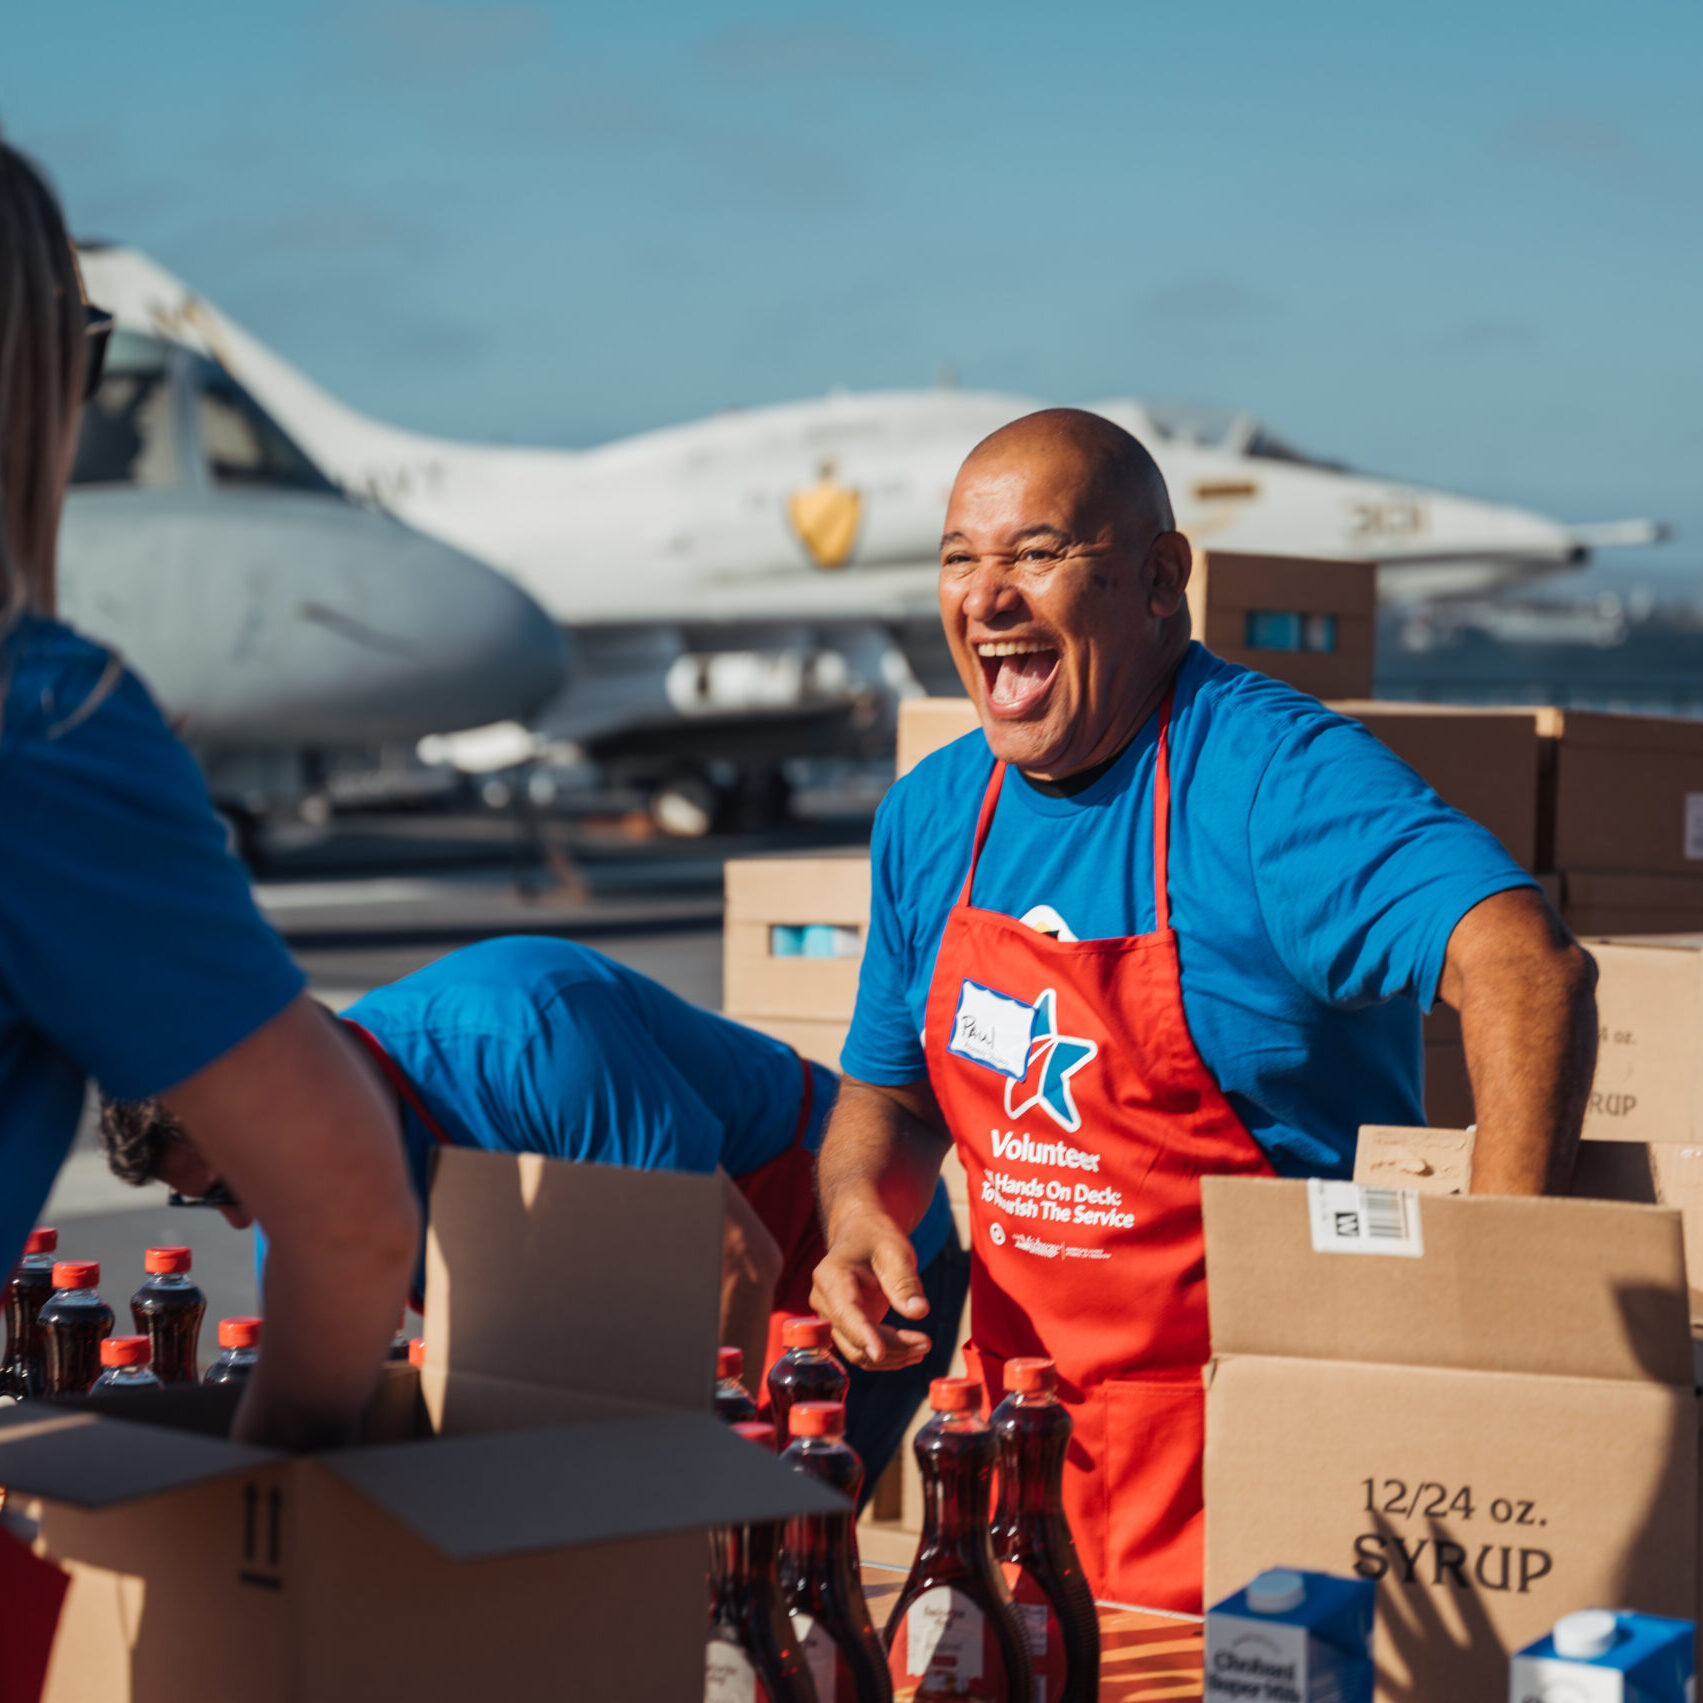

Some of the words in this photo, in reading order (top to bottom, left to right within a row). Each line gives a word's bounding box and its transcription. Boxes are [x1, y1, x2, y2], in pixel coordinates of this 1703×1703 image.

[1588, 1092, 1637, 1116] RUP
[991, 1129, 1100, 1172] Volunteer
[995, 1172, 1045, 1197] Hands
[1046, 1181, 1071, 1202] On
[1074, 1183, 1122, 1207] Deck:
[1040, 1201, 1071, 1222] The
[1073, 1205, 1135, 1229] Service
[1361, 1477, 1475, 1520] 12/24
[1490, 1497, 1548, 1527] oz.
[1353, 1533, 1553, 1594] SYRUP
